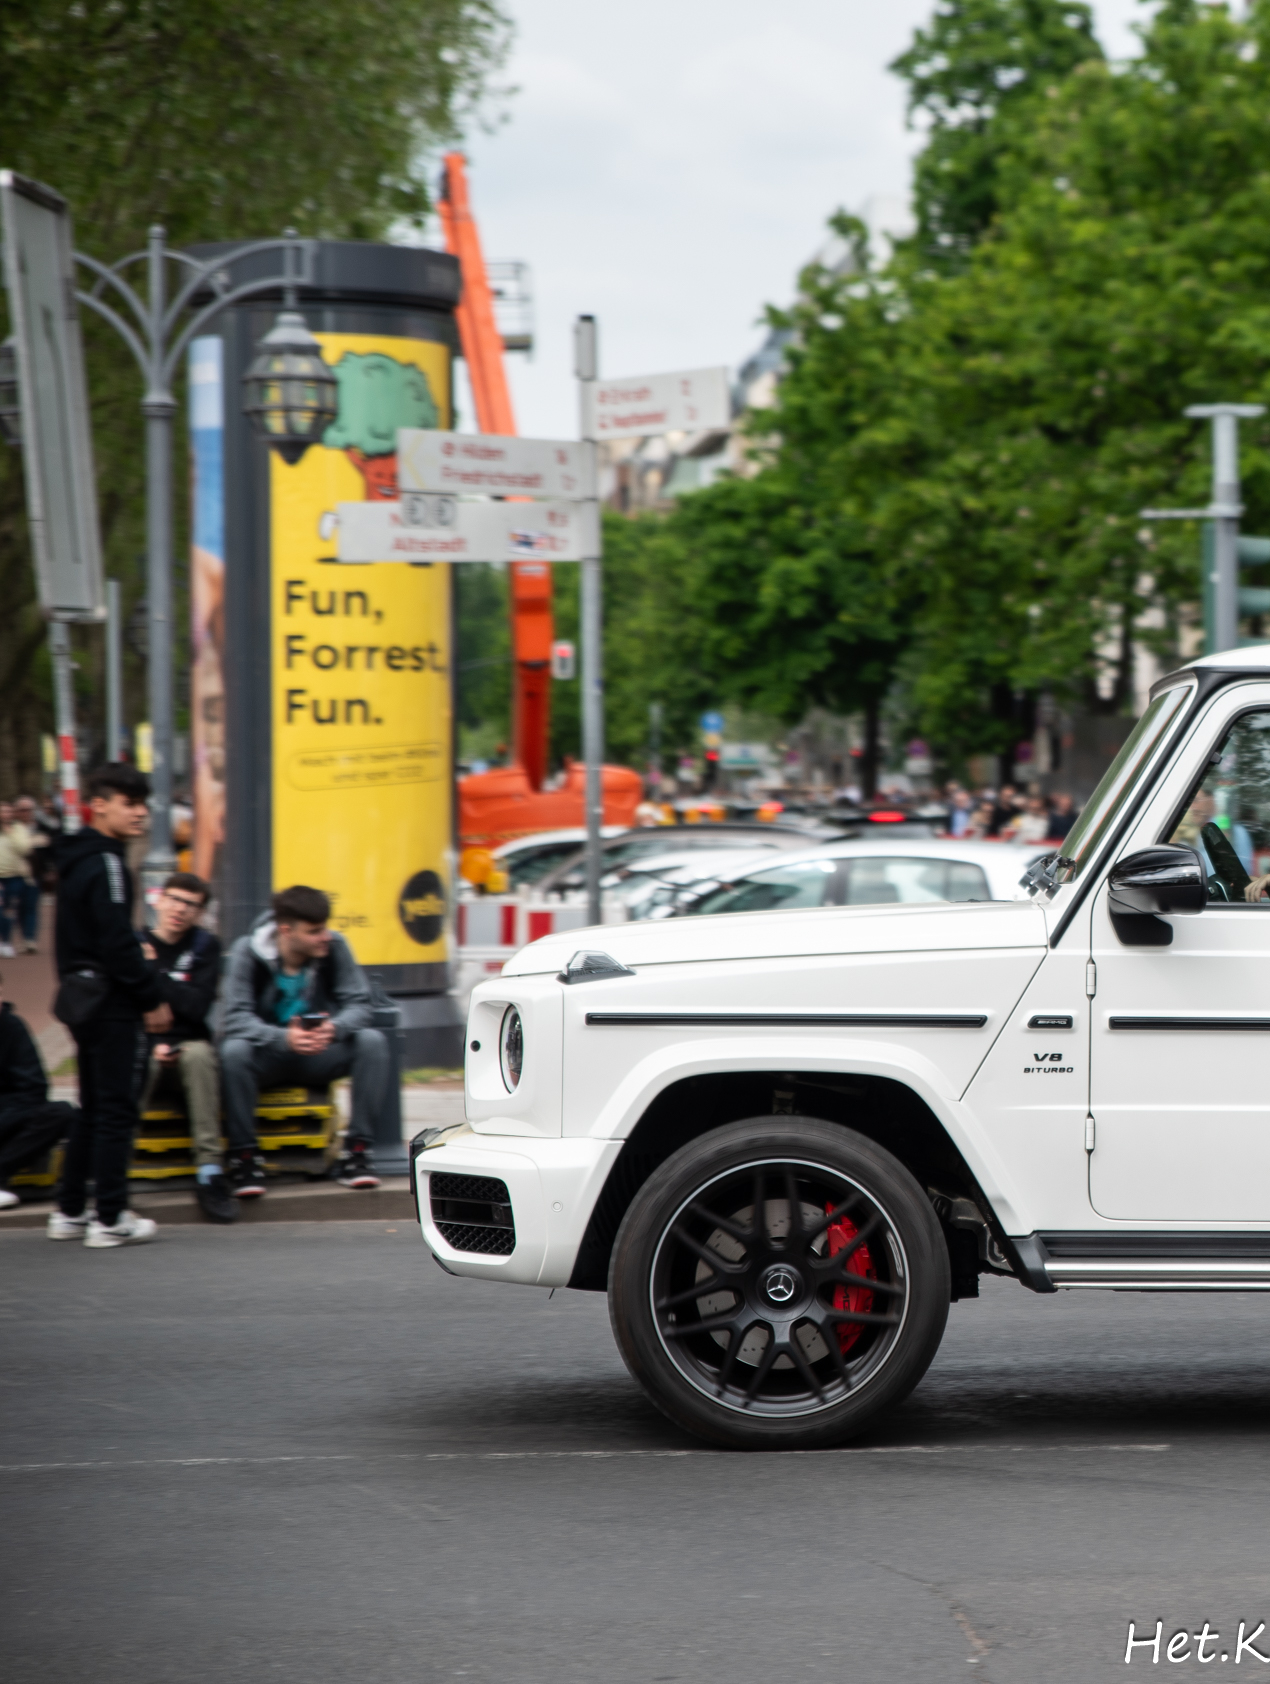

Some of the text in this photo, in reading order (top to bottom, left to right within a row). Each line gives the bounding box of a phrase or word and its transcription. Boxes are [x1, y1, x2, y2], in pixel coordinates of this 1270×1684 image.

[285, 580, 384, 624] Fun,
[285, 689, 383, 725] Fun.
[1033, 1053, 1063, 1062] V8
